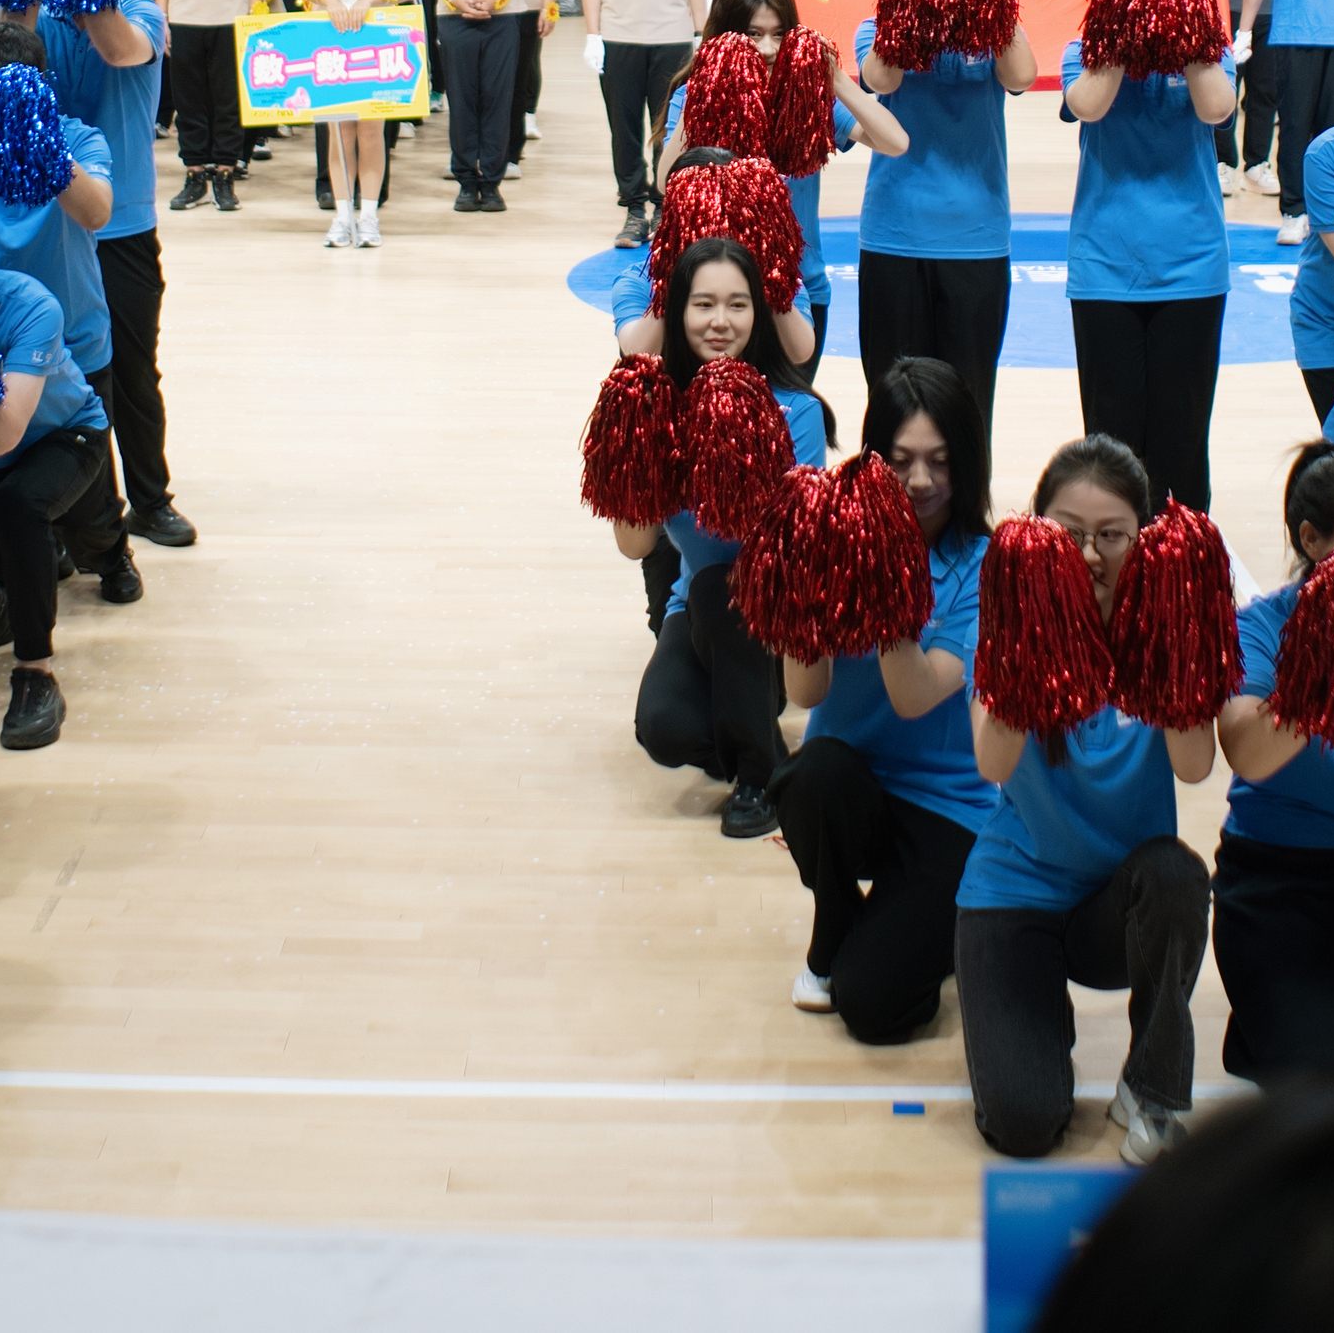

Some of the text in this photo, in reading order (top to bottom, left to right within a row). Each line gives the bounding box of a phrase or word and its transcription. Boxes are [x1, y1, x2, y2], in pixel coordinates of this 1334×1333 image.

[252, 45, 412, 87] 数一数二队
